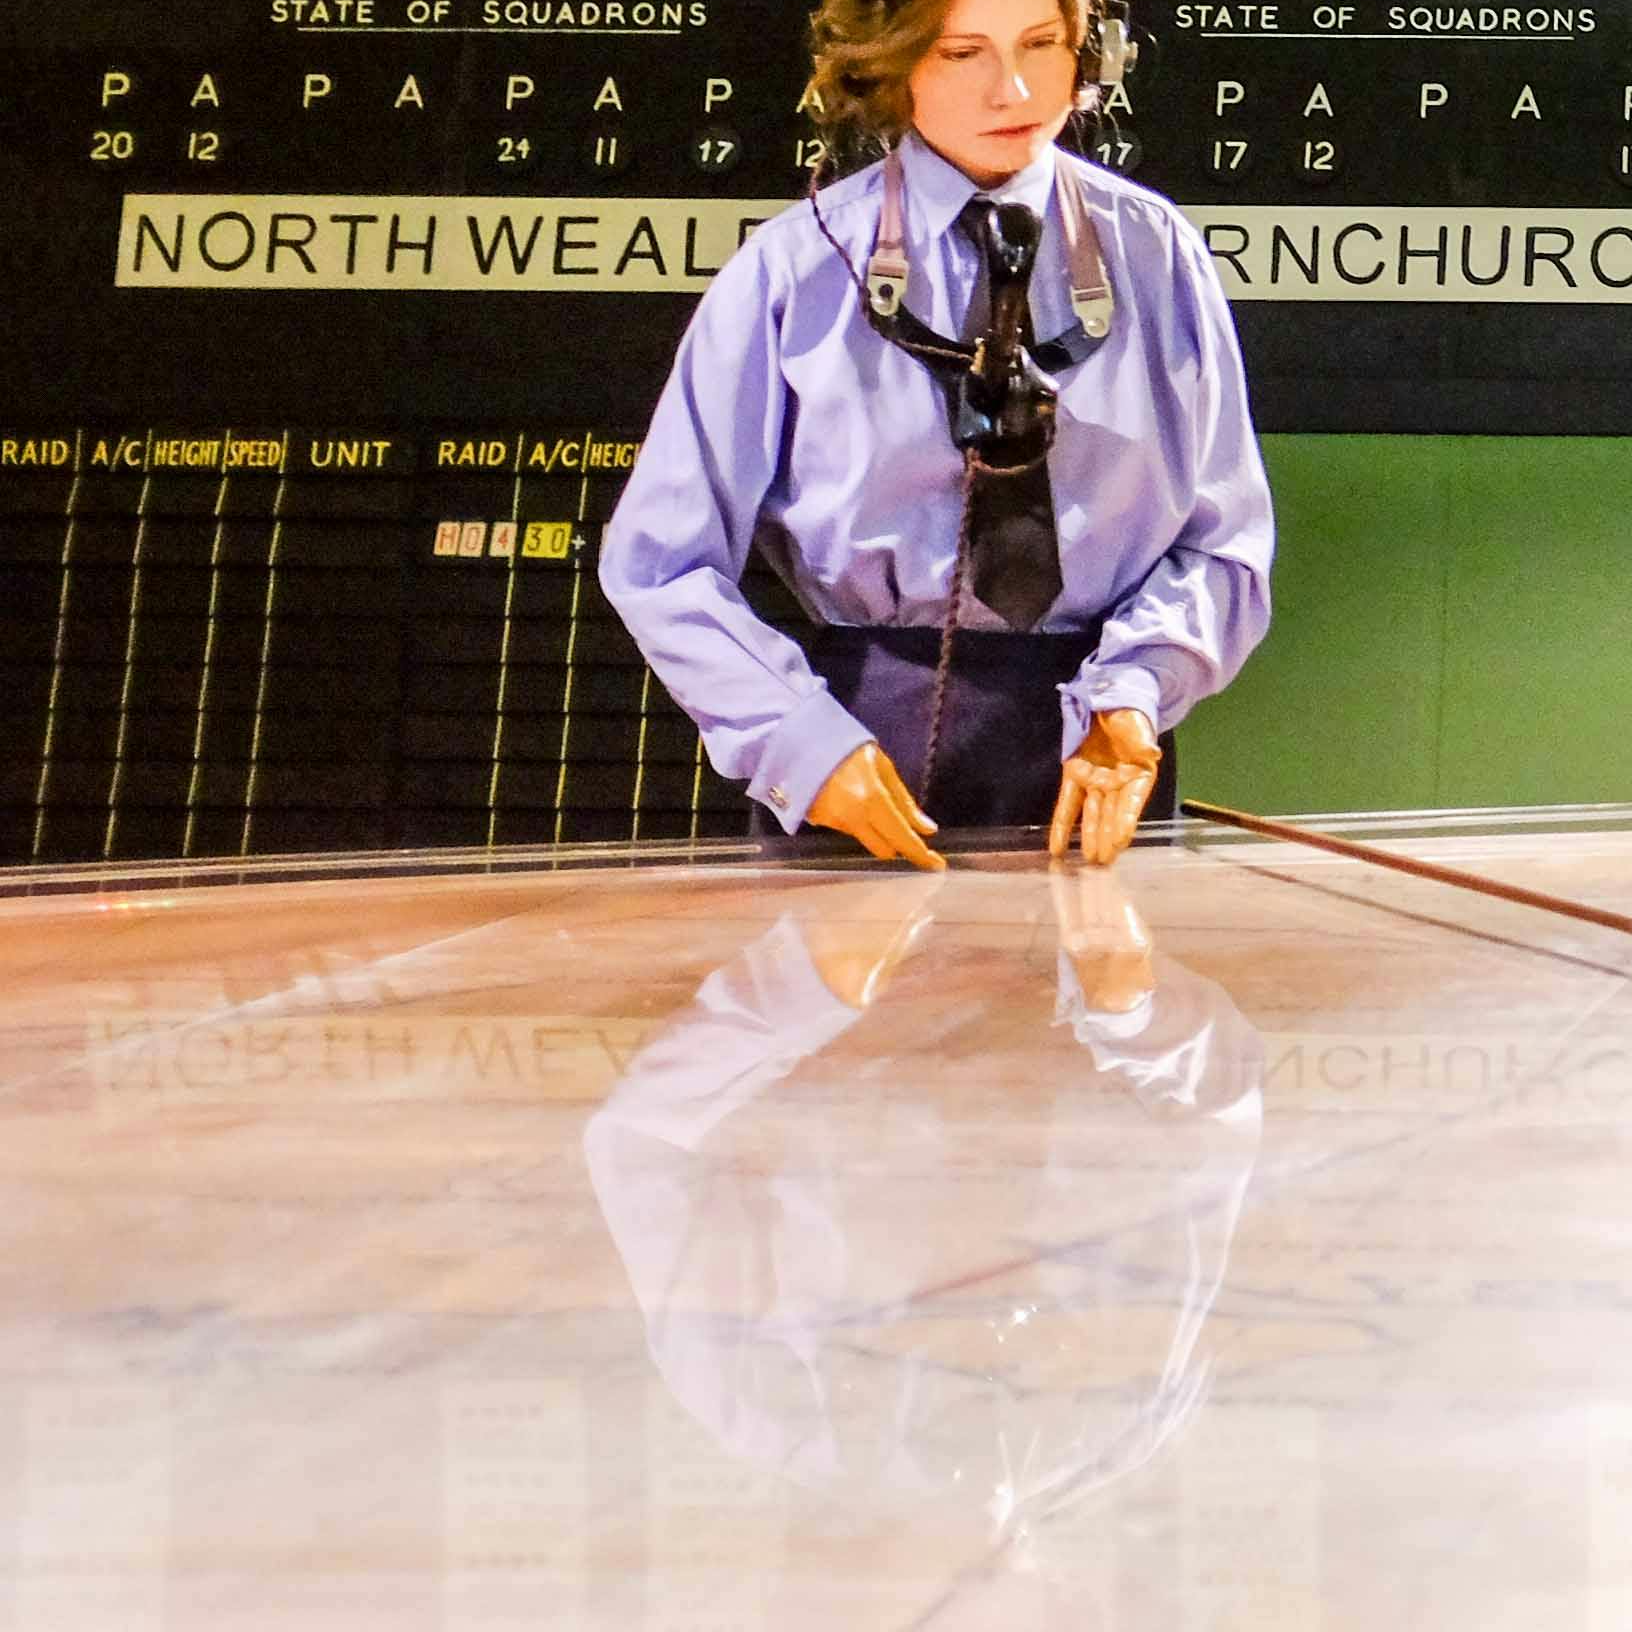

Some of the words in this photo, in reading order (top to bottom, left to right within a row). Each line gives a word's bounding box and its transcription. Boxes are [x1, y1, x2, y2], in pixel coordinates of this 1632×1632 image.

[271, 0, 373, 23] STATE
[407, 1, 450, 23] OF
[483, 0, 706, 25] SQUADRONS
[103, 73, 130, 106] P
[191, 74, 218, 106] A
[91, 132, 133, 159] 20
[189, 132, 218, 160] 12
[134, 211, 436, 274] NORTH
[467, 216, 767, 277] WEAL
[2, 440, 68, 465] RAID
[92, 437, 141, 466] A/C
[155, 441, 220, 465] HEIGHT
[225, 437, 280, 466] SPEED
[311, 441, 390, 467] UNIT
[439, 442, 505, 465] RAID
